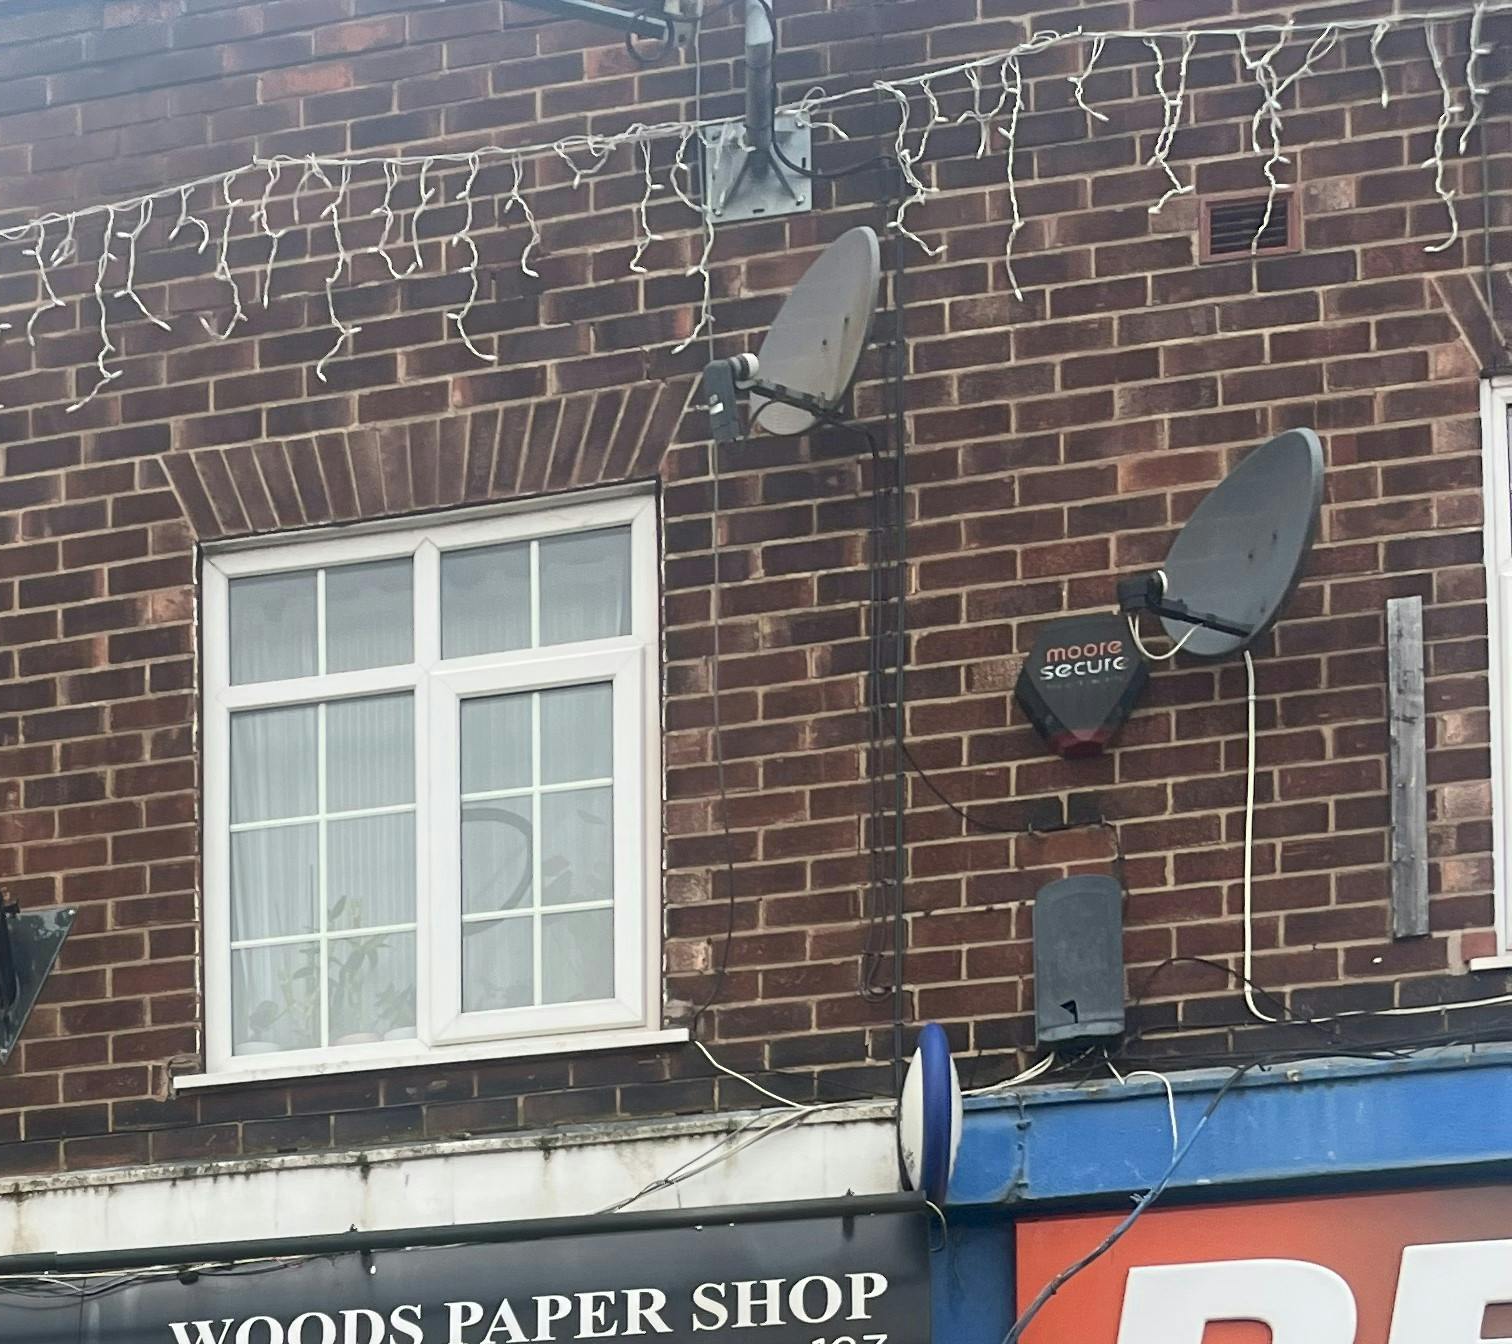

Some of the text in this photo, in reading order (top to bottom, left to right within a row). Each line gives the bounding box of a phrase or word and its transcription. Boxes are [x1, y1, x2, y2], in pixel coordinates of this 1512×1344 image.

[1046, 640, 1123, 663] moore
[1040, 657, 1129, 680] secure
[692, 1272, 888, 1331] SHOP
